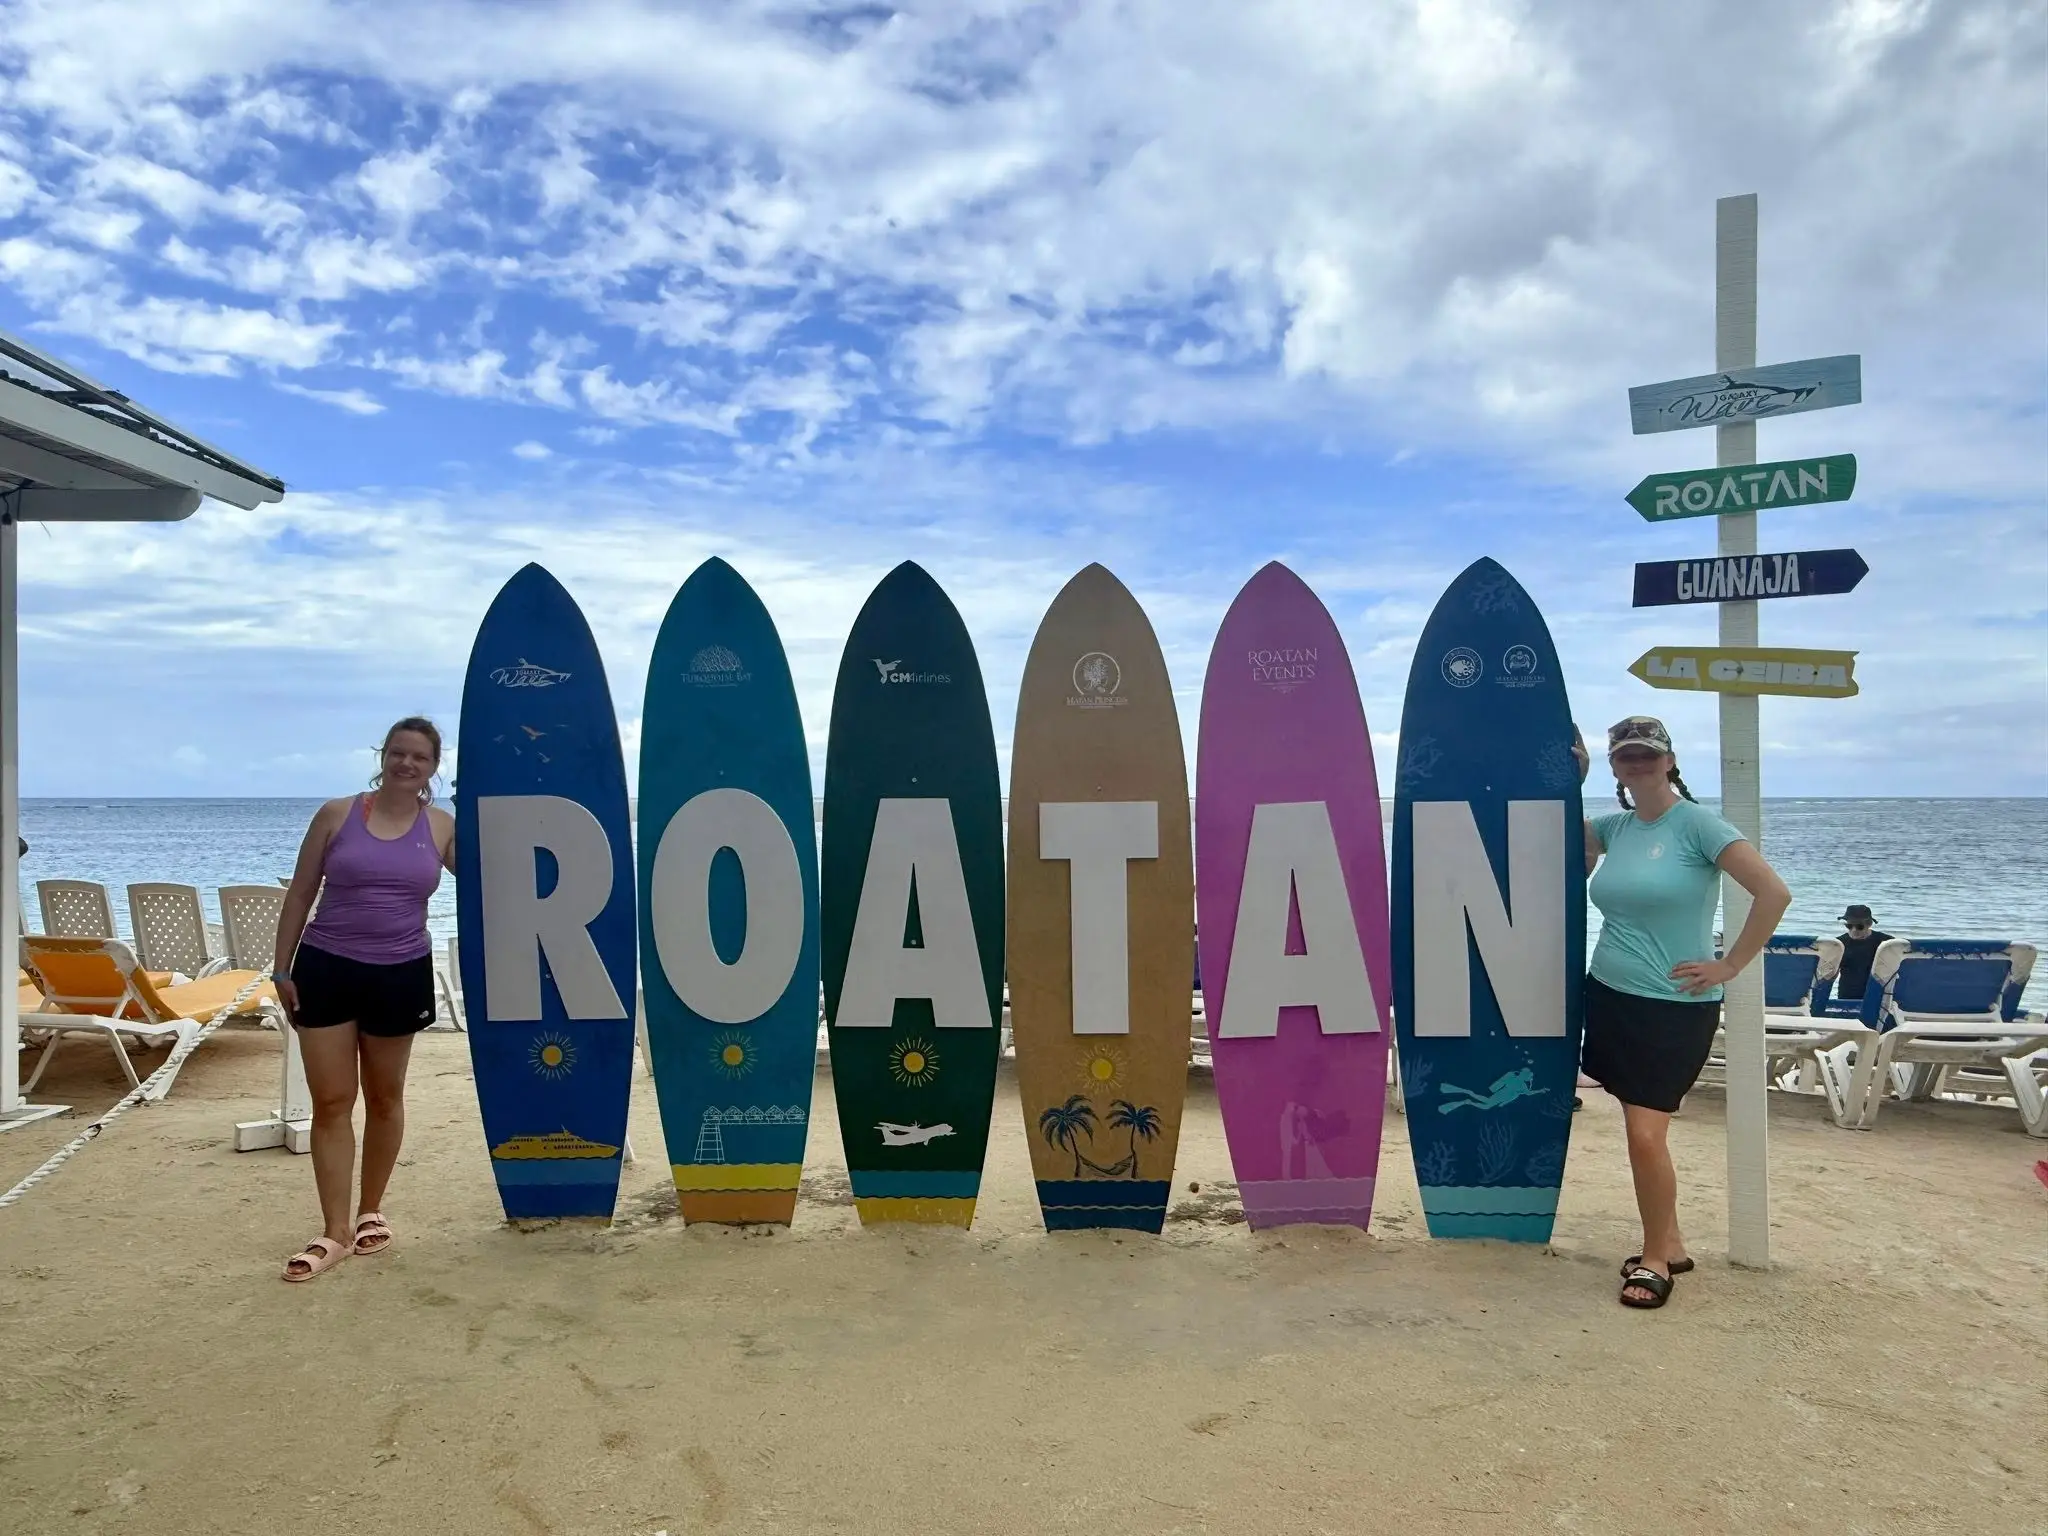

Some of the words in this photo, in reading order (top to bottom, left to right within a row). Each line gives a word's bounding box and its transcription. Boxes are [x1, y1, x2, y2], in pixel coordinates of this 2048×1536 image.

[1655, 463, 1828, 516] ROATAN
[1677, 554, 1800, 600] GUANAJA
[1248, 648, 1318, 666] ROATAN
[1253, 664, 1316, 681] EVENTS
[1646, 656, 1698, 680] LA
[1708, 659, 1848, 688] CEIBA
[477, 787, 1567, 1039] ROATAN
